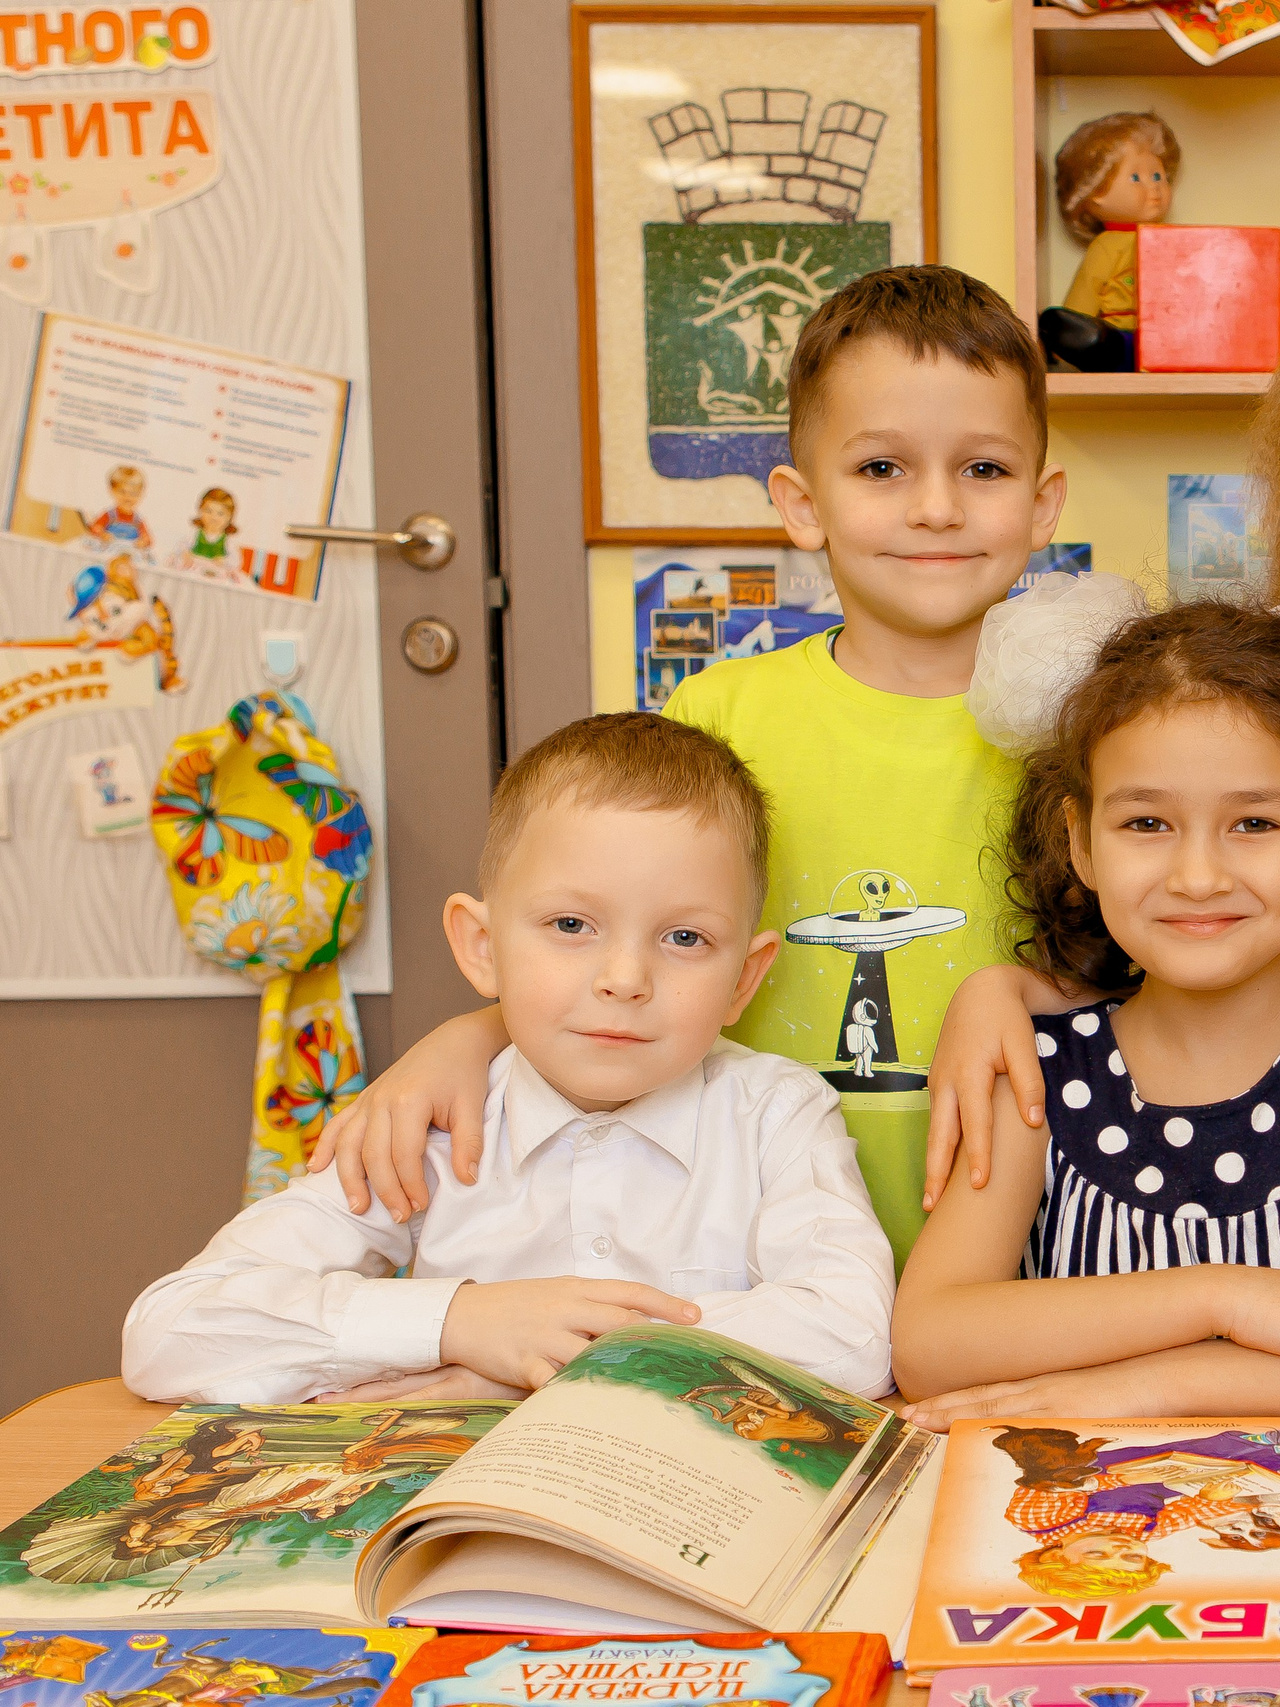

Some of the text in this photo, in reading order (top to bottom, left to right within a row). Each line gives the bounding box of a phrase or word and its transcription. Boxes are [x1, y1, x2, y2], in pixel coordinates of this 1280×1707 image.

[0, 7, 209, 67] ТНОГО
[574, 1500, 632, 1527] глубоком
[624, 1496, 669, 1519] старуха
[626, 1513, 681, 1542] морского
[654, 1518, 704, 1547] Морской
[700, 1516, 719, 1529] Все
[639, 1528, 676, 1548] самом
[679, 1545, 716, 1570] В
[587, 1649, 695, 1660] СКАЗКИ
[520, 1661, 750, 1682] ЛЯГУШКА
[500, 1679, 748, 1702] ЦАРЕВНА-
